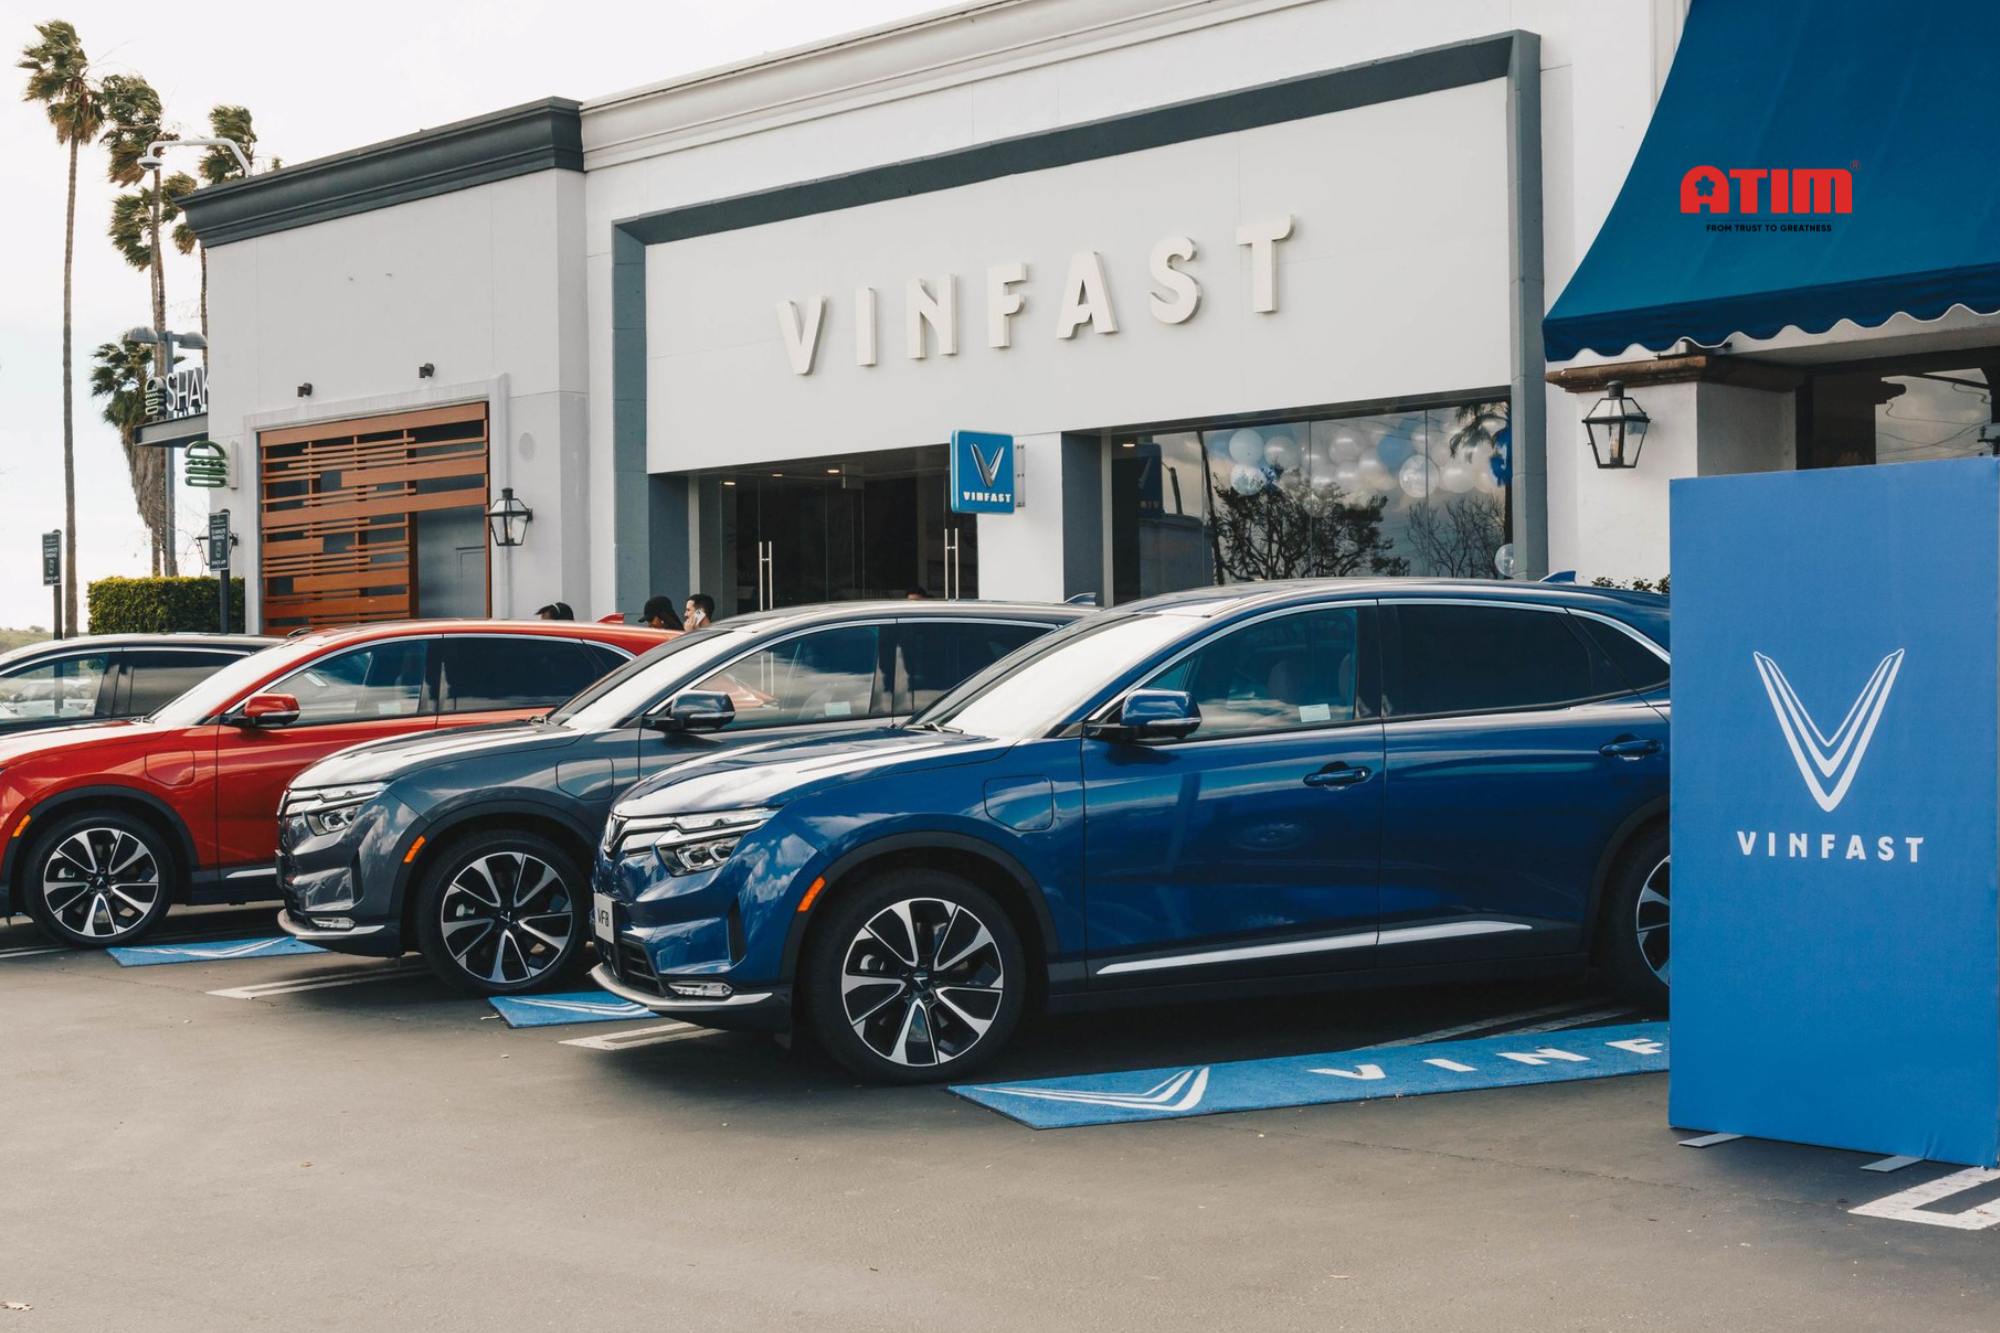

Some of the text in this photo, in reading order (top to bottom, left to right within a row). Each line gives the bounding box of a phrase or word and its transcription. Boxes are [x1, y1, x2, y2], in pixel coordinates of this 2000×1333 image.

[777, 214, 1296, 377] VINFAST
[963, 491, 1011, 503] VINFAST
[1737, 831, 1924, 863] VINFAST
